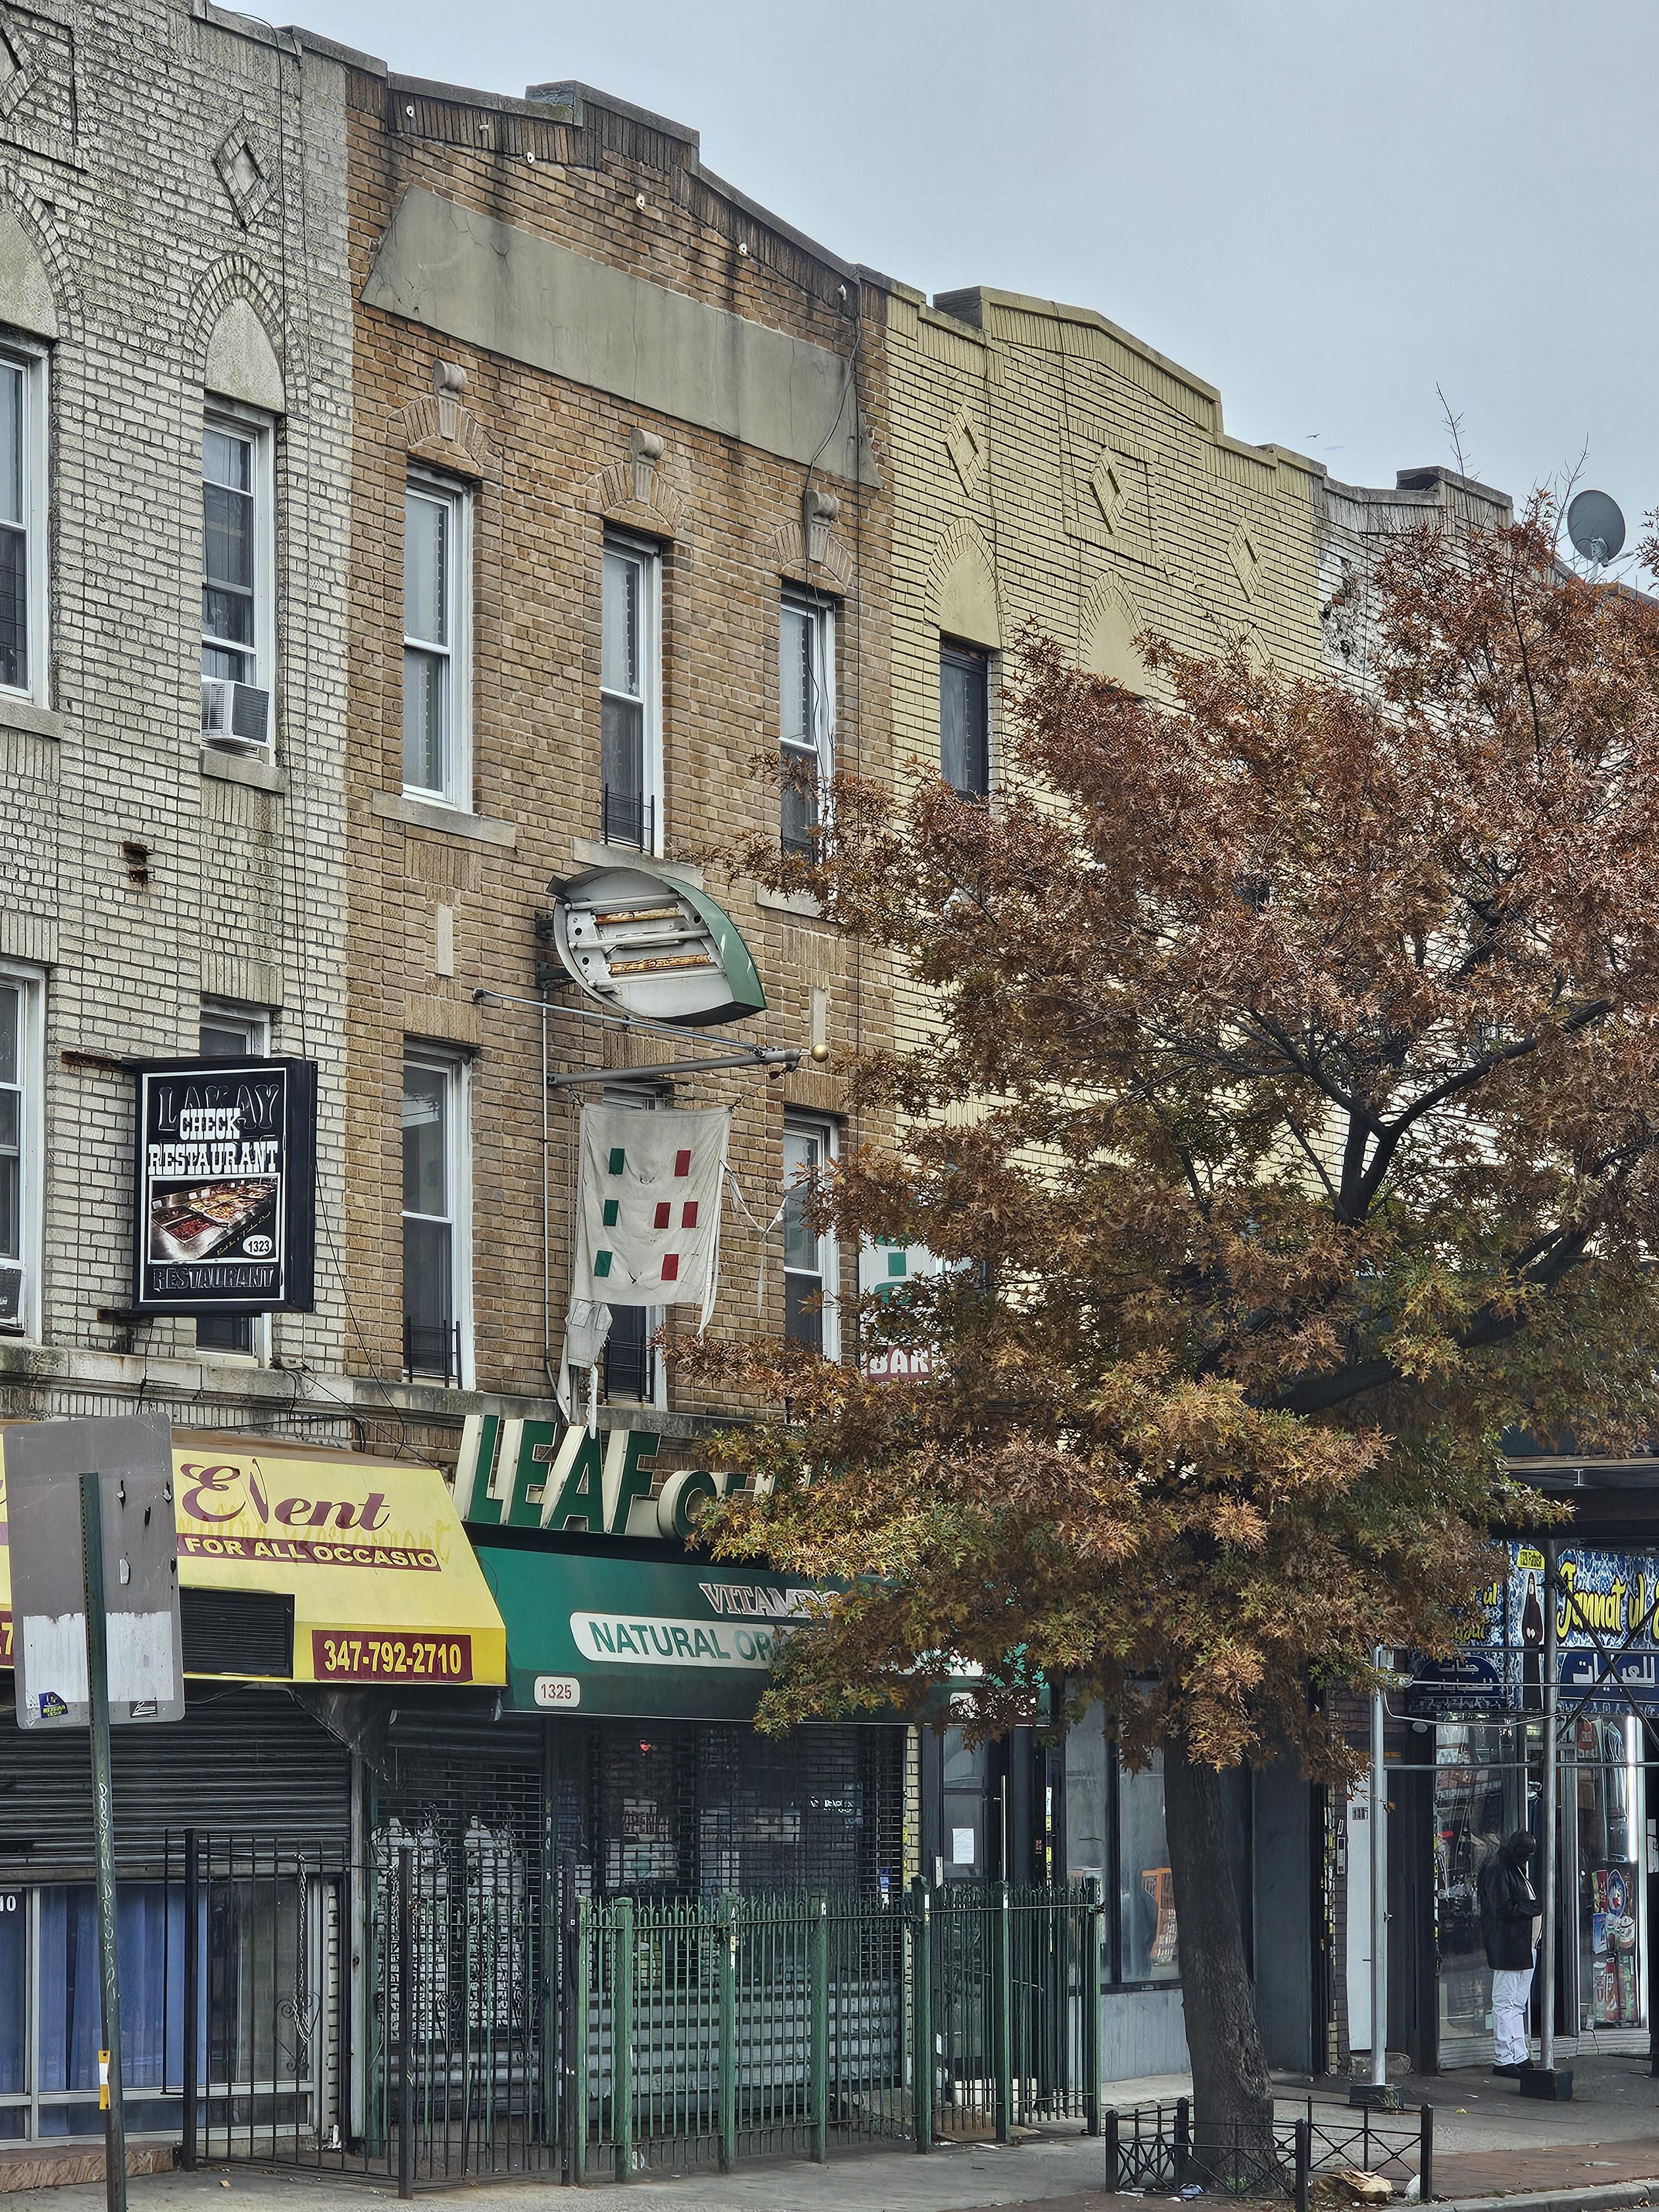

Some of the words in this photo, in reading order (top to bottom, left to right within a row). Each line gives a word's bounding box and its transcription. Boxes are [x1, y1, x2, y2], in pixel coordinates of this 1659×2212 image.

[180, 1108, 241, 1140] CHECK
[148, 1141, 278, 1175] RESTAURANT
[248, 1240, 270, 1253] 1323
[154, 1266, 274, 1290] RESTAURANT
[460, 1415, 660, 1534] LEAF
[184, 1537, 247, 1556] FOR
[254, 1542, 307, 1559] ALL
[313, 1545, 438, 1568] OCCASIO
[589, 1621, 731, 1660] NATURAL
[324, 1640, 462, 1676] 347-792-2710
[541, 1683, 572, 1700] 1325
